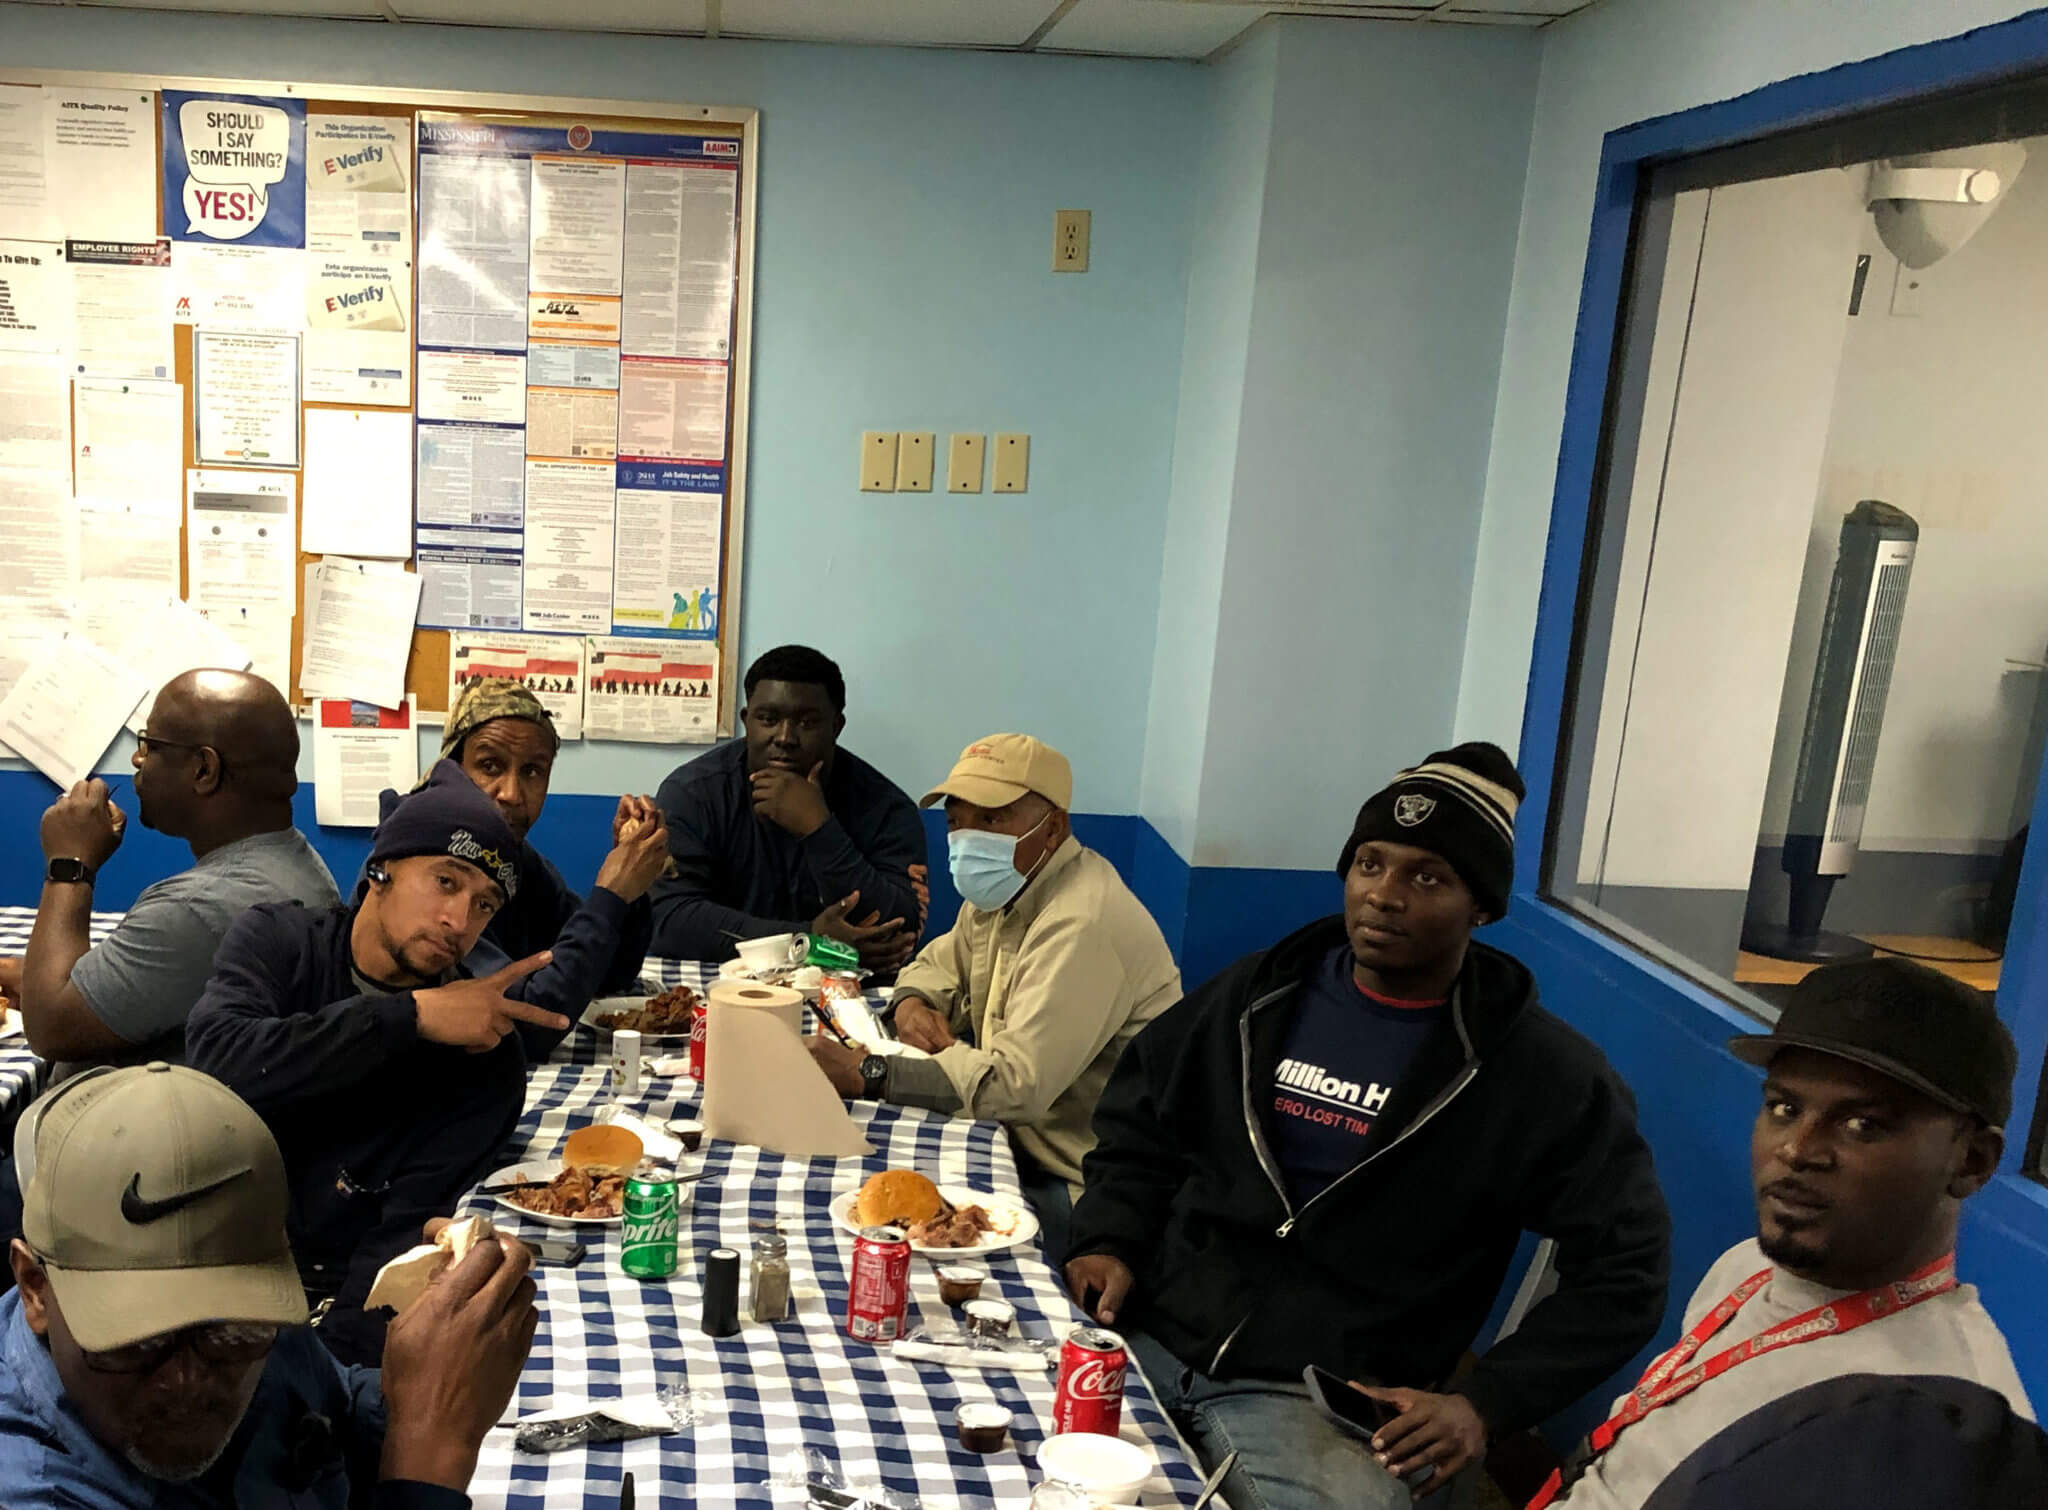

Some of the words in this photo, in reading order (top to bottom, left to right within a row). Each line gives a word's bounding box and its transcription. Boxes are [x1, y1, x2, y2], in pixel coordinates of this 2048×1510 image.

[80, 103, 106, 111] Quality
[107, 104, 129, 112] Policy
[207, 112, 264, 130] SHOULD
[325, 123, 339, 131] This
[340, 124, 386, 132] Organization
[218, 131, 222, 147] I
[226, 132, 254, 149] SAY
[315, 131, 358, 139] Participates
[191, 150, 282, 168] SOMETHING?
[336, 146, 383, 169] Verify
[194, 190, 254, 221] YES!
[72, 243, 120, 252] EMPLOYEE
[122, 245, 156, 254] RIGHTS
[337, 285, 384, 308] Verify
[697, 480, 720, 488] LAW!
[1274, 1058, 1361, 1103] Million
[1274, 1097, 1304, 1116] ERO
[1304, 1105, 1343, 1128] LOST
[1345, 1117, 1369, 1136] TIM
